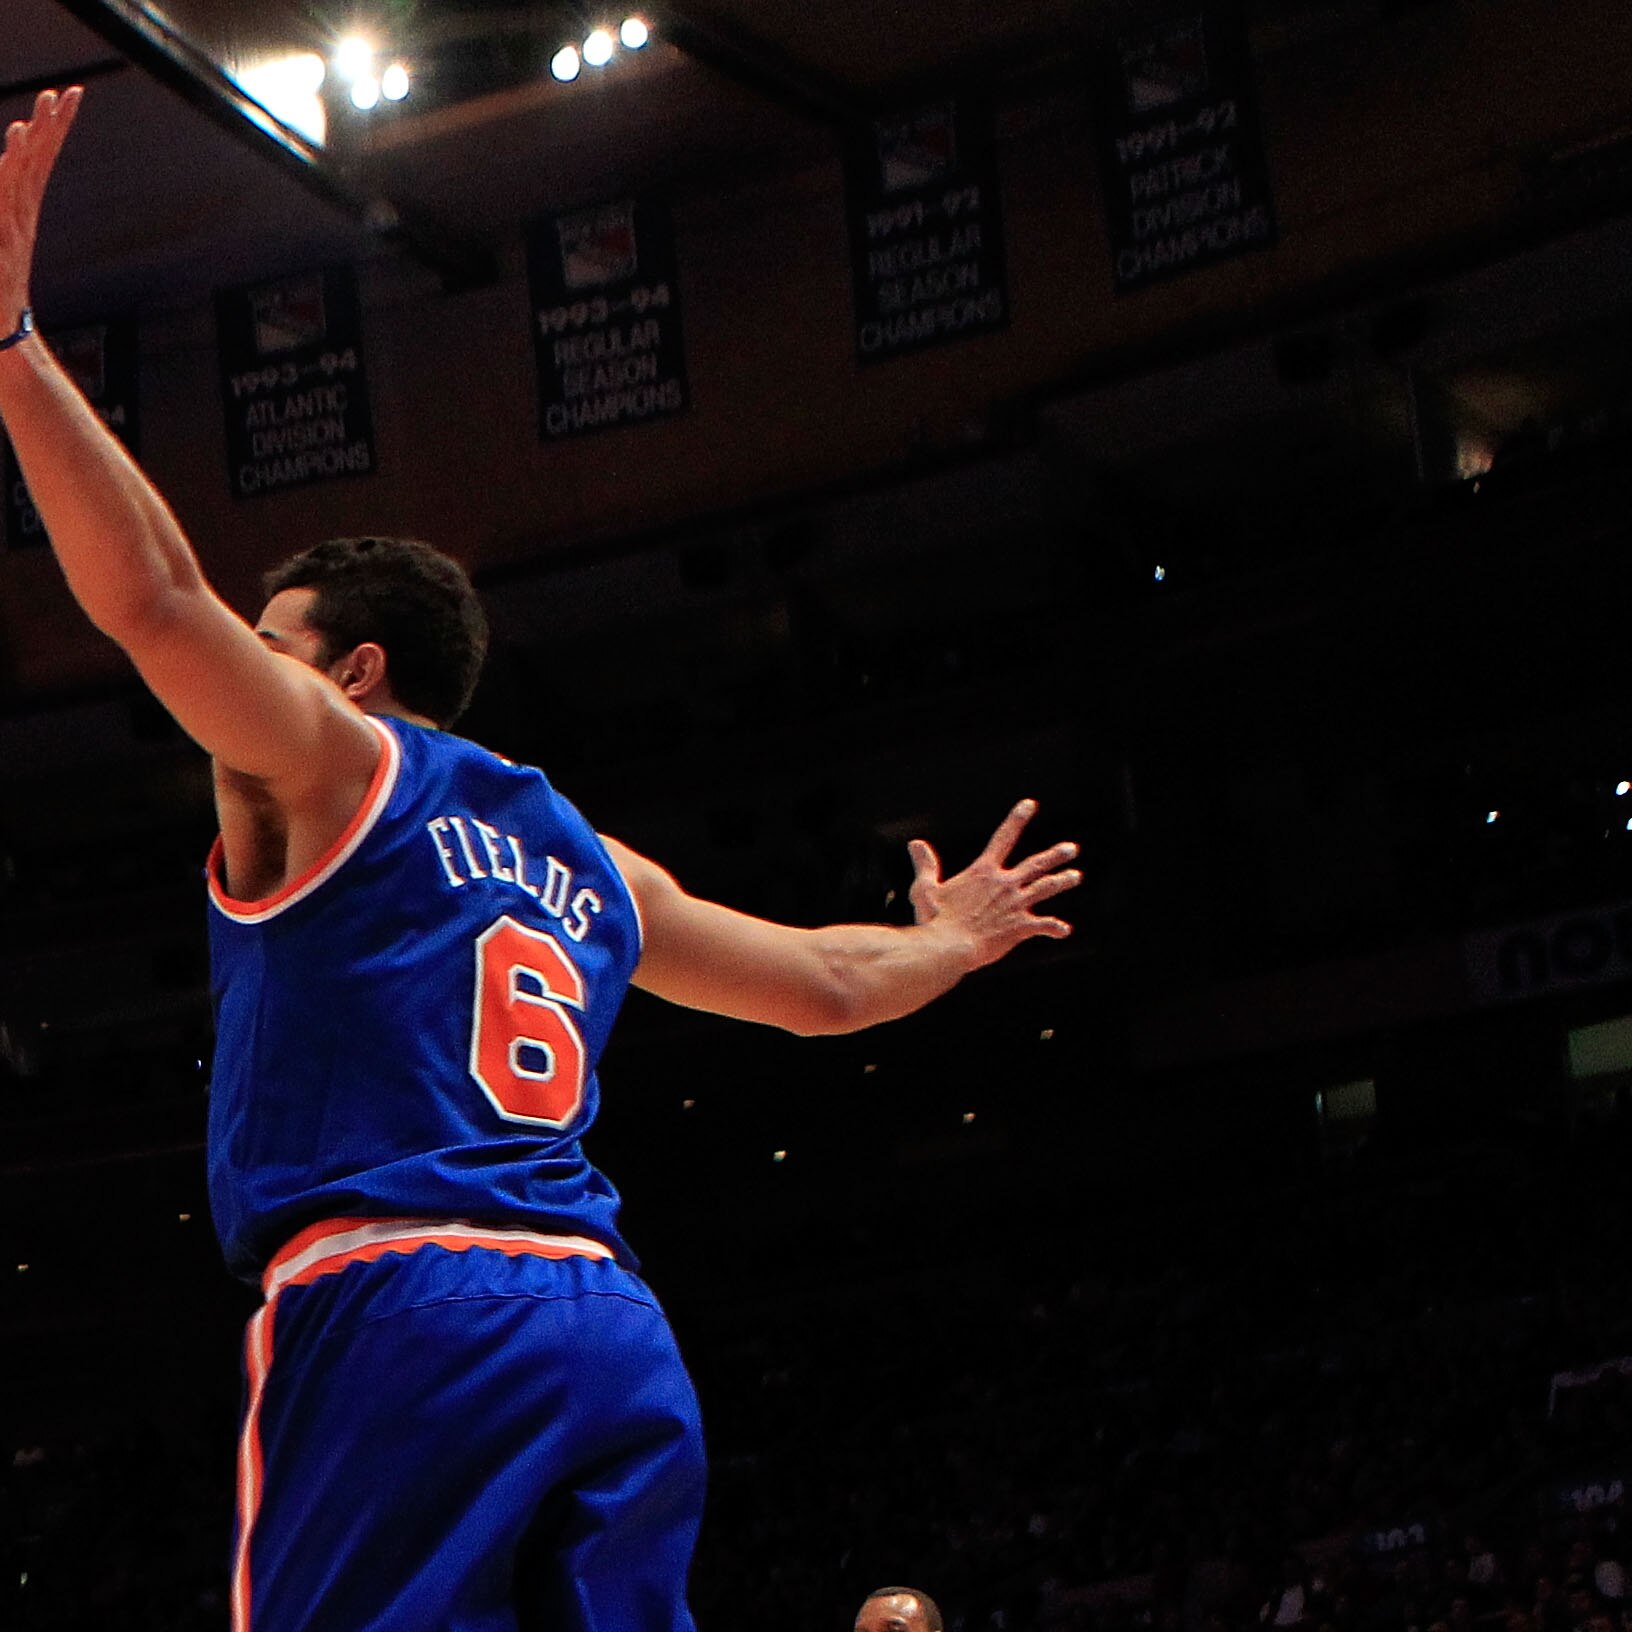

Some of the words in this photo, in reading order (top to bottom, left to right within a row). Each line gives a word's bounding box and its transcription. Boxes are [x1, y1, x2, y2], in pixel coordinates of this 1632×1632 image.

[239, 438, 371, 492] CHAMPIONS
[427, 816, 602, 943] FIELDS
[469, 914, 586, 1131] 6
